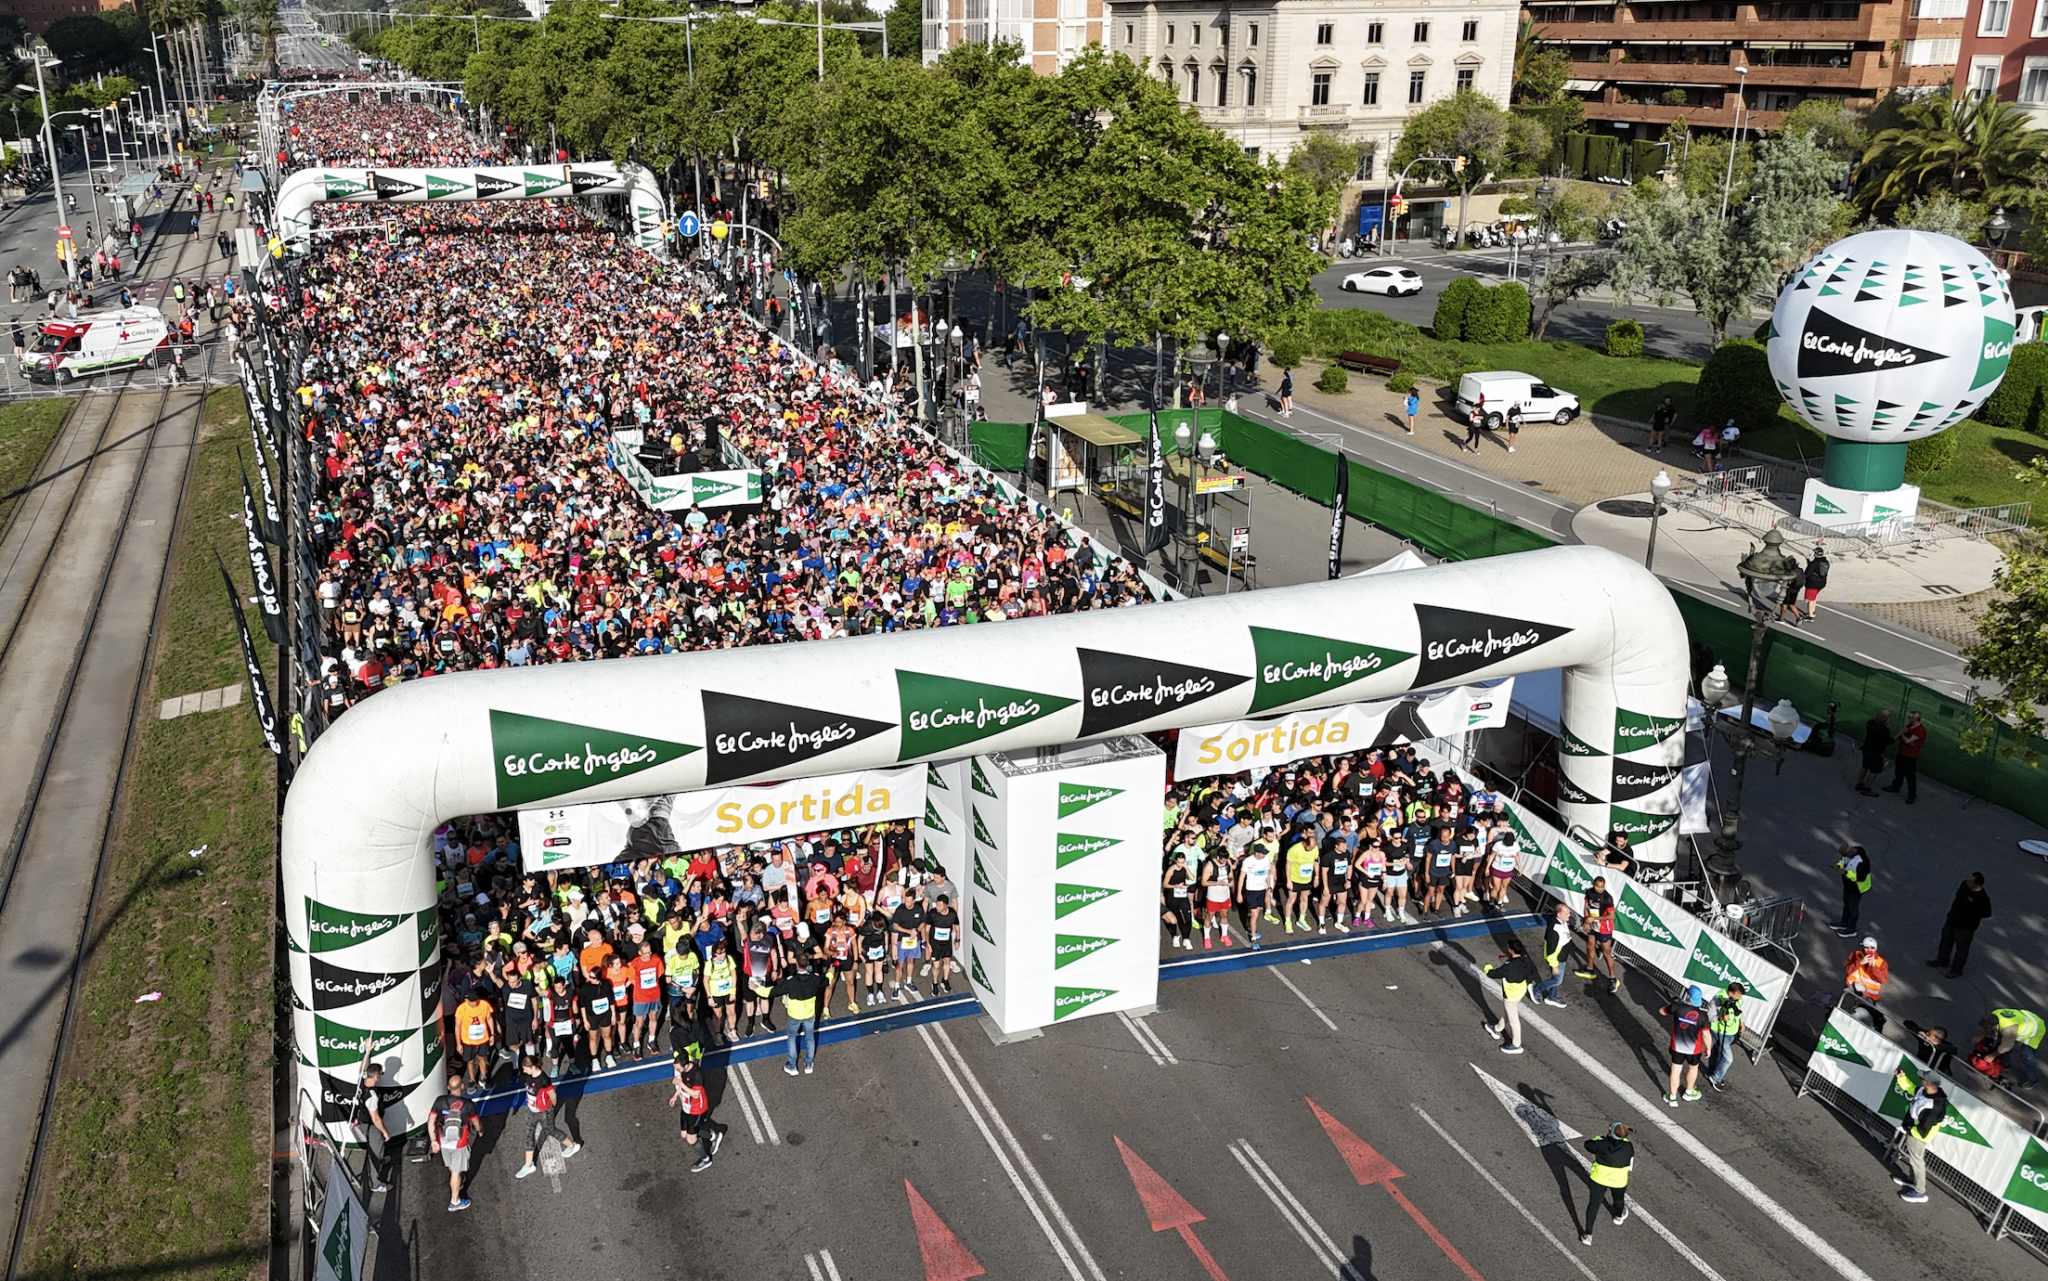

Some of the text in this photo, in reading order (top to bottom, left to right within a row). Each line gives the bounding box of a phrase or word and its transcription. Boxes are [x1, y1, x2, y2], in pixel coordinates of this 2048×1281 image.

[146, 327, 160, 335] Roja
[1803, 331, 1916, 367] El Corte Inglés
[1984, 342, 1995, 360] El
[1150, 470, 1164, 509] Corte
[1150, 508, 1164, 527] El
[265, 594, 280, 615] El
[1428, 628, 1540, 660] El Corte Inglés
[1263, 652, 1382, 684] El Corte Inglés
[1091, 675, 1215, 707] El Corte Inglés
[910, 698, 1040, 732] El Corte Inglés
[716, 721, 856, 755] El Corte Inglés
[1618, 720, 1680, 738] El Corte Inglés
[1197, 718, 1350, 764] Sortida
[504, 742, 656, 776] El Corte Inglés
[1616, 774, 1626, 784] El
[1626, 774, 1650, 785] Corte
[716, 783, 891, 834] Sortida
[1613, 822, 1624, 832] El
[1624, 823, 1648, 833] Corte
[1551, 856, 1558, 869] El
[1558, 862, 1575, 879] Corte
[310, 918, 393, 938] El Corte Inglés
[1617, 900, 1672, 942] El Corte Inglés
[1693, 948, 1702, 962] El
[1700, 954, 1722, 974] Corte
[314, 976, 396, 996] El Corte Inglés
[319, 1035, 329, 1048] El
[329, 1036, 358, 1050] Corte
[1820, 1034, 1848, 1054] nglés
[324, 1090, 334, 1103] El
[335, 1094, 359, 1106] Cort
[2020, 1164, 2035, 1182] El
